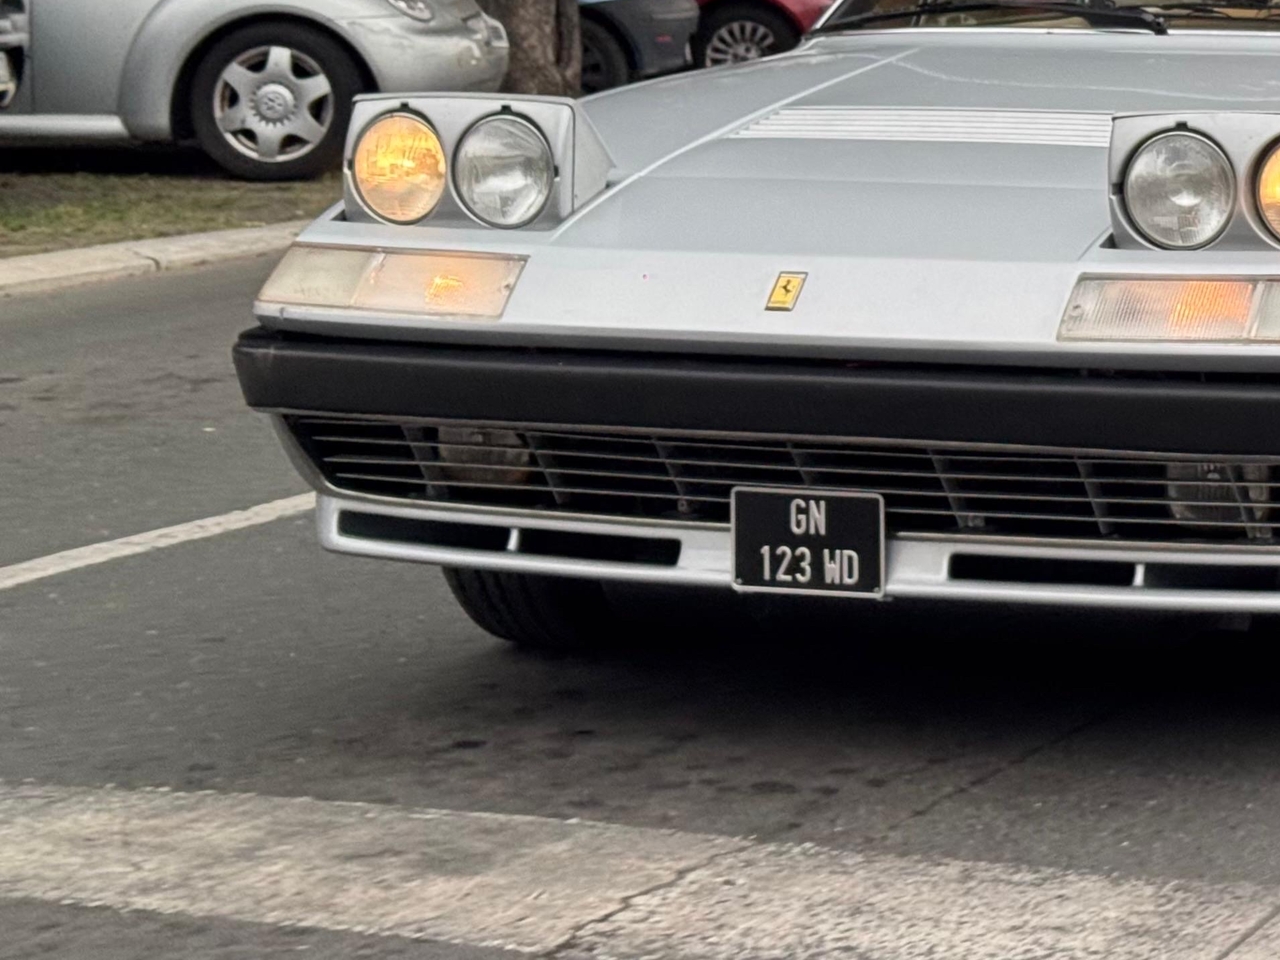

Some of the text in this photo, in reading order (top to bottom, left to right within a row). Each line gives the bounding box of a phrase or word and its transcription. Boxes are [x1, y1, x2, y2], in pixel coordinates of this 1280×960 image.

[790, 499, 827, 536] GN
[760, 545, 860, 585] 123 WD
